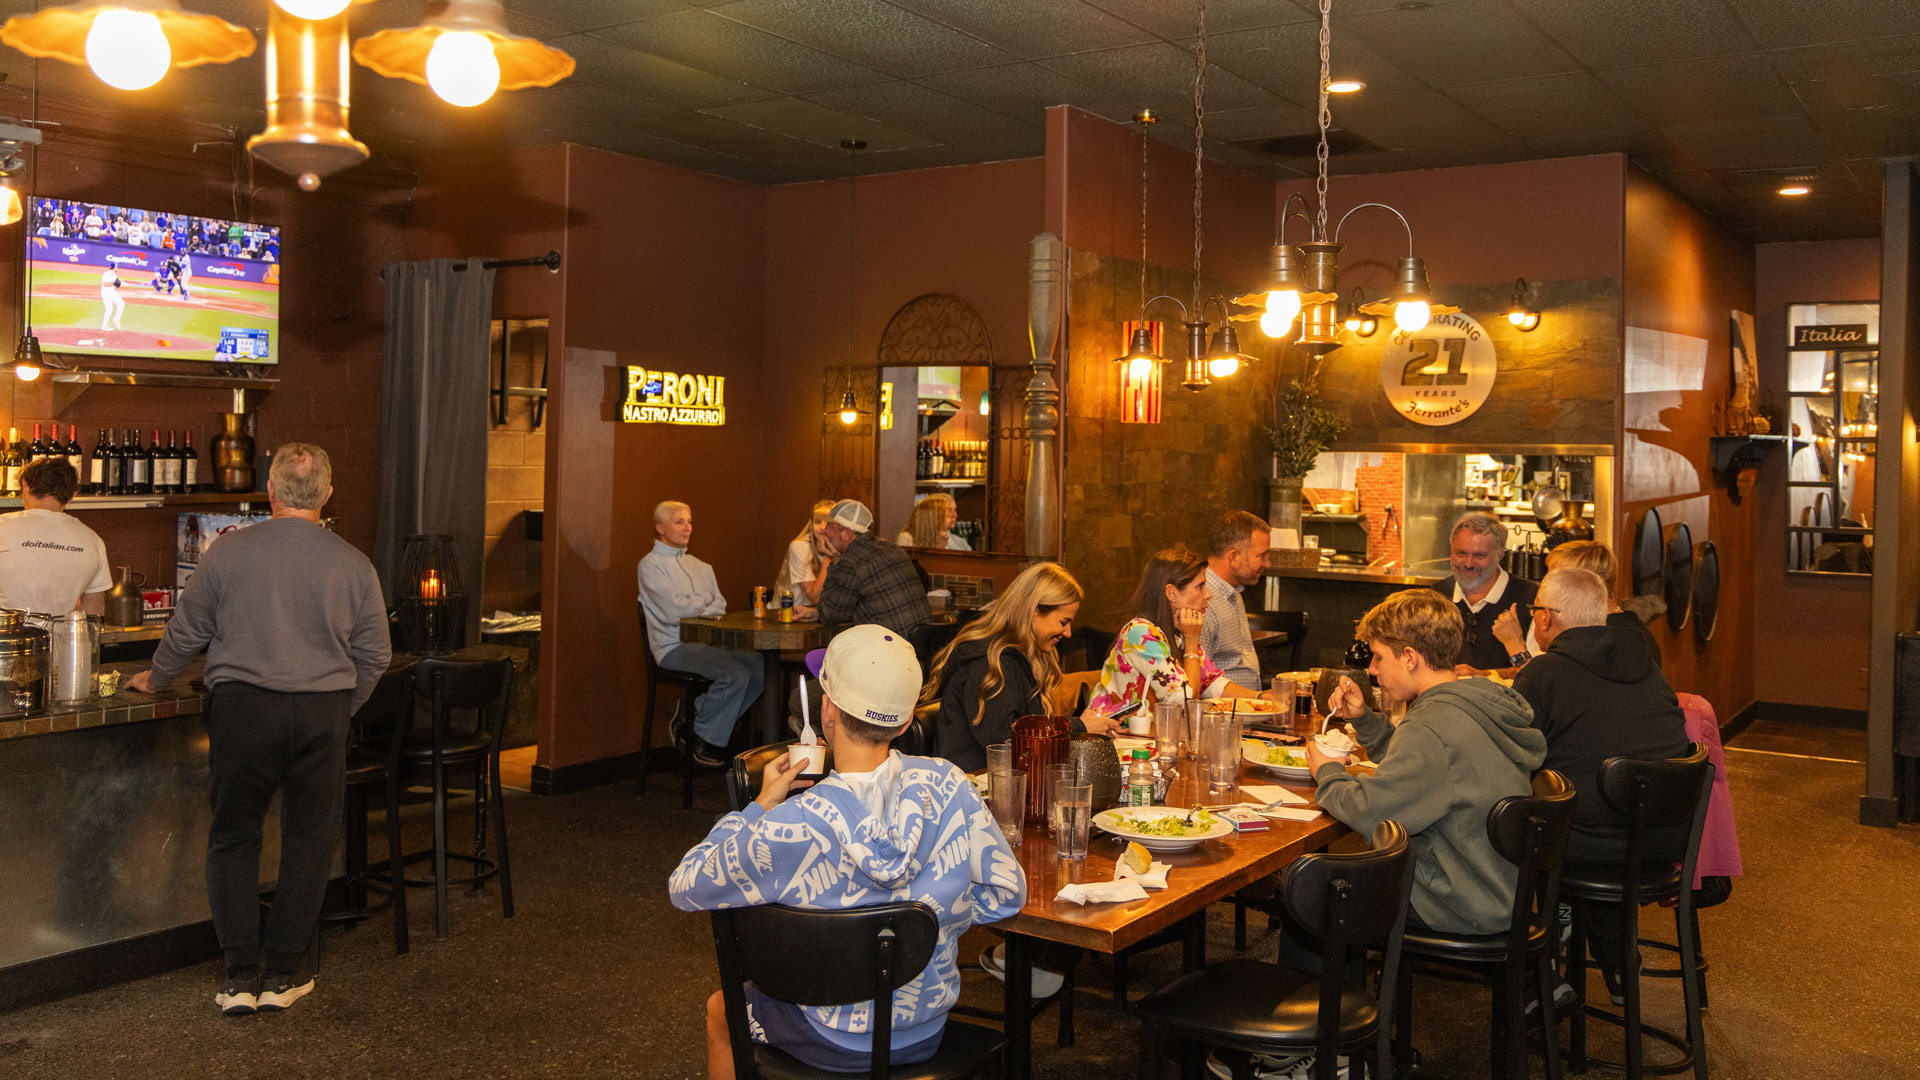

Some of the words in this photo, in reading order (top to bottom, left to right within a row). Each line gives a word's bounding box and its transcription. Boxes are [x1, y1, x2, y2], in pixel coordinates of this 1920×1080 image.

[1394, 313, 1481, 346] CERATING
[1800, 327, 1863, 343] Italia
[1401, 338, 1468, 386] 21
[626, 365, 726, 408] PERONI
[623, 405, 669, 421] NASTRO
[668, 407, 720, 423] AZZURRO
[21, 540, 84, 553] doitalian.com
[865, 709, 899, 722] HUSKIES
[805, 797, 821, 810] do
[823, 805, 839, 823] it
[774, 825, 793, 838] do
[932, 830, 970, 881] NIKE
[795, 858, 839, 905] NIKE
[852, 1008, 868, 1027] it
